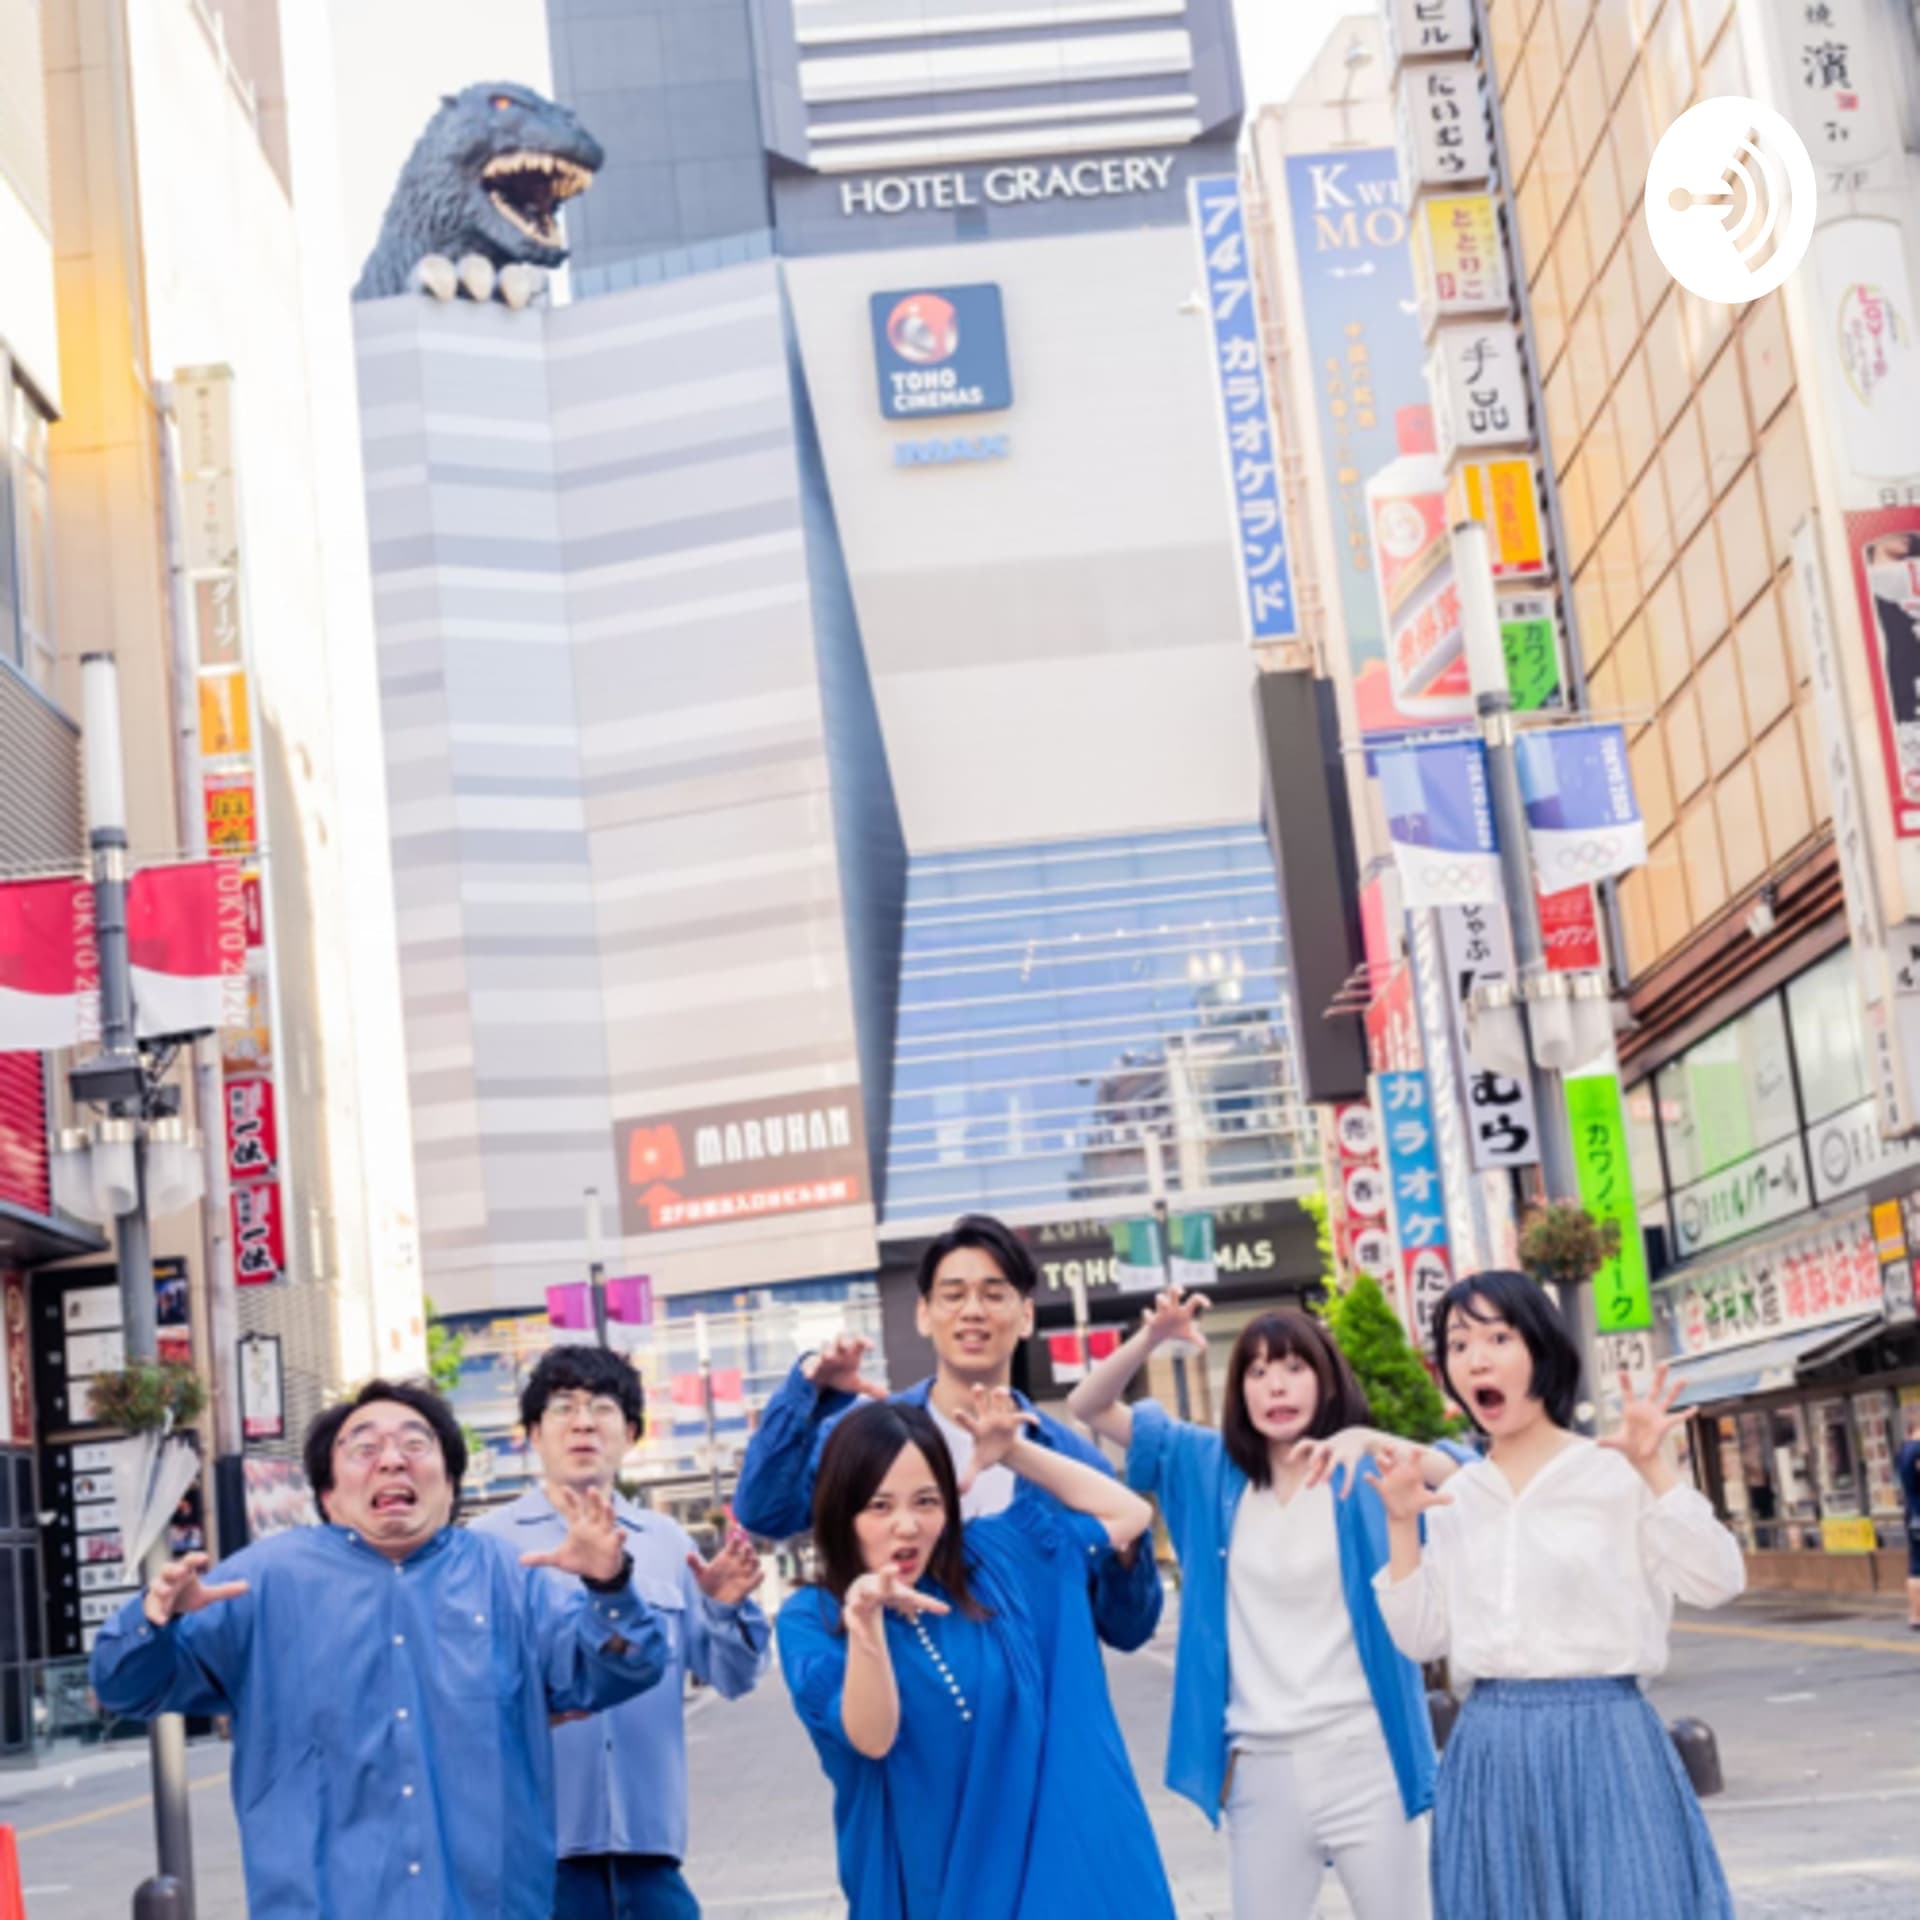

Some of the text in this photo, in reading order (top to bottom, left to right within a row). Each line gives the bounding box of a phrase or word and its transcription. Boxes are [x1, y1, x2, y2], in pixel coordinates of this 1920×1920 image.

[840, 155, 1174, 215] HOTEL GRACERY
[891, 367, 957, 392] TOHO
[894, 386, 983, 411] CINEMAS
[217, 858, 246, 951] TOKYO
[695, 1105, 850, 1168] MARUHAN
[1387, 1075, 1442, 1248] カラオケ
